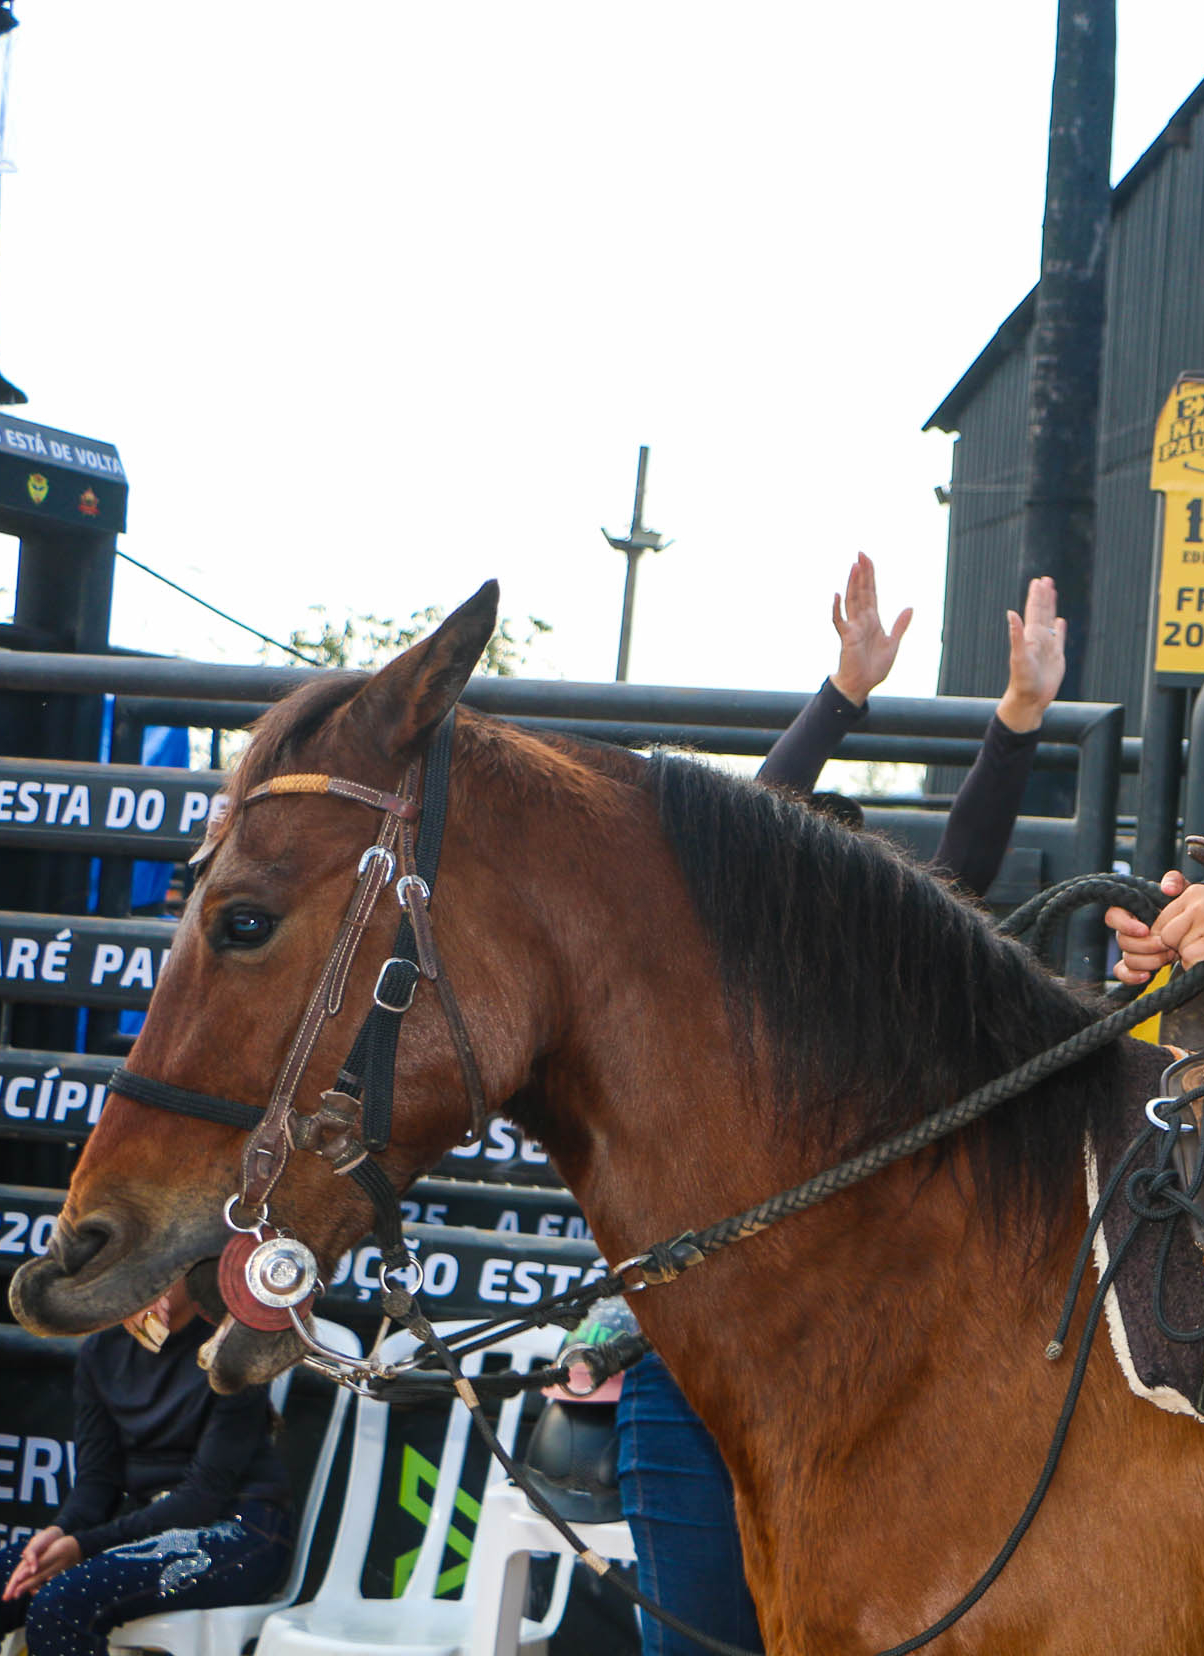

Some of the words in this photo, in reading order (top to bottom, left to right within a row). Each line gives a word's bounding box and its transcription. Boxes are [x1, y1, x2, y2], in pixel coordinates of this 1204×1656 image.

[5, 431, 49, 456] ESTÁ
[50, 440, 74, 463] DE
[75, 447, 123, 475] VOLTA
[0, 779, 91, 827] ESTA
[105, 786, 166, 831] DO
[0, 927, 72, 982] RÉ
[90, 943, 172, 989] PA
[0, 1066, 108, 1126] CÍPI
